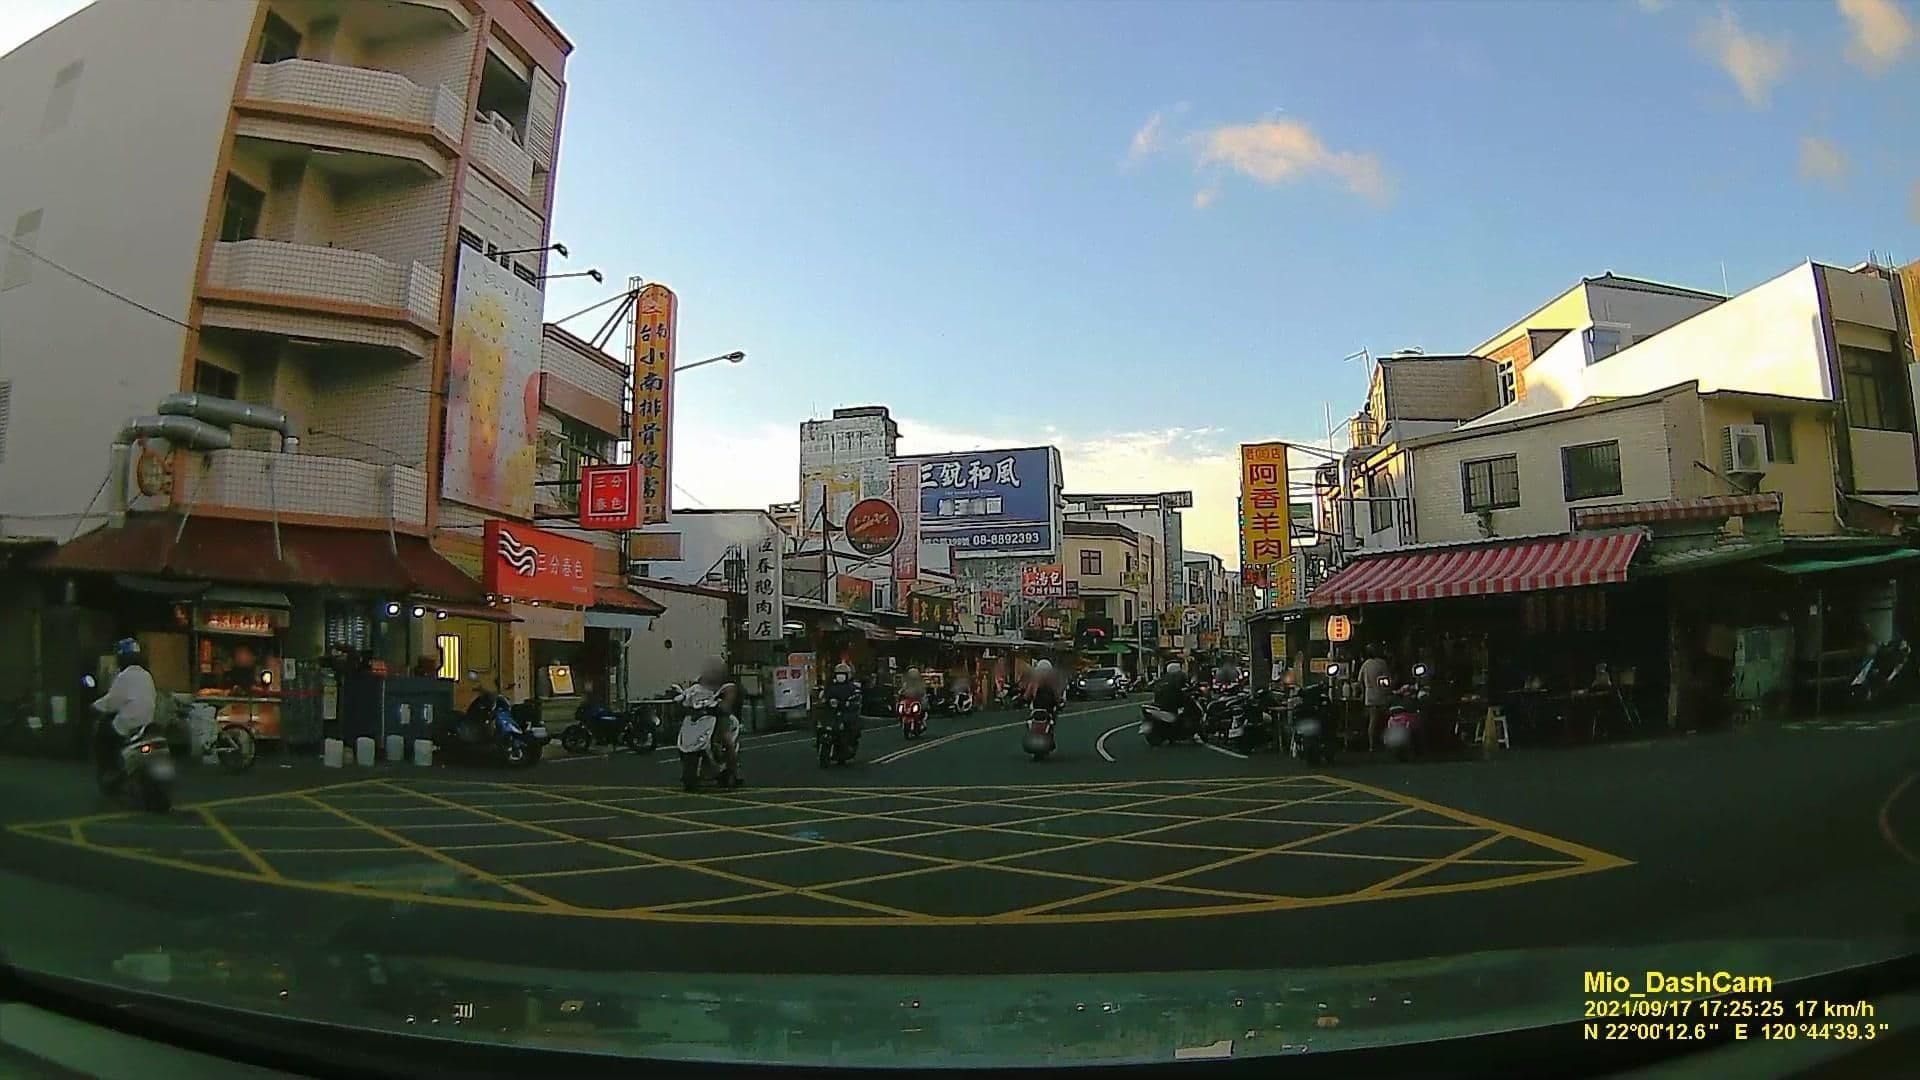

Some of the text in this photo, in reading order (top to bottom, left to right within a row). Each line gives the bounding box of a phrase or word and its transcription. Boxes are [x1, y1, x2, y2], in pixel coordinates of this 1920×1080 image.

[593, 475, 623, 489] 三分
[1249, 463, 1282, 560] 阿香羊肉
[972, 532, 1040, 546] 08-8892393
[537, 553, 584, 579] 三分春色
